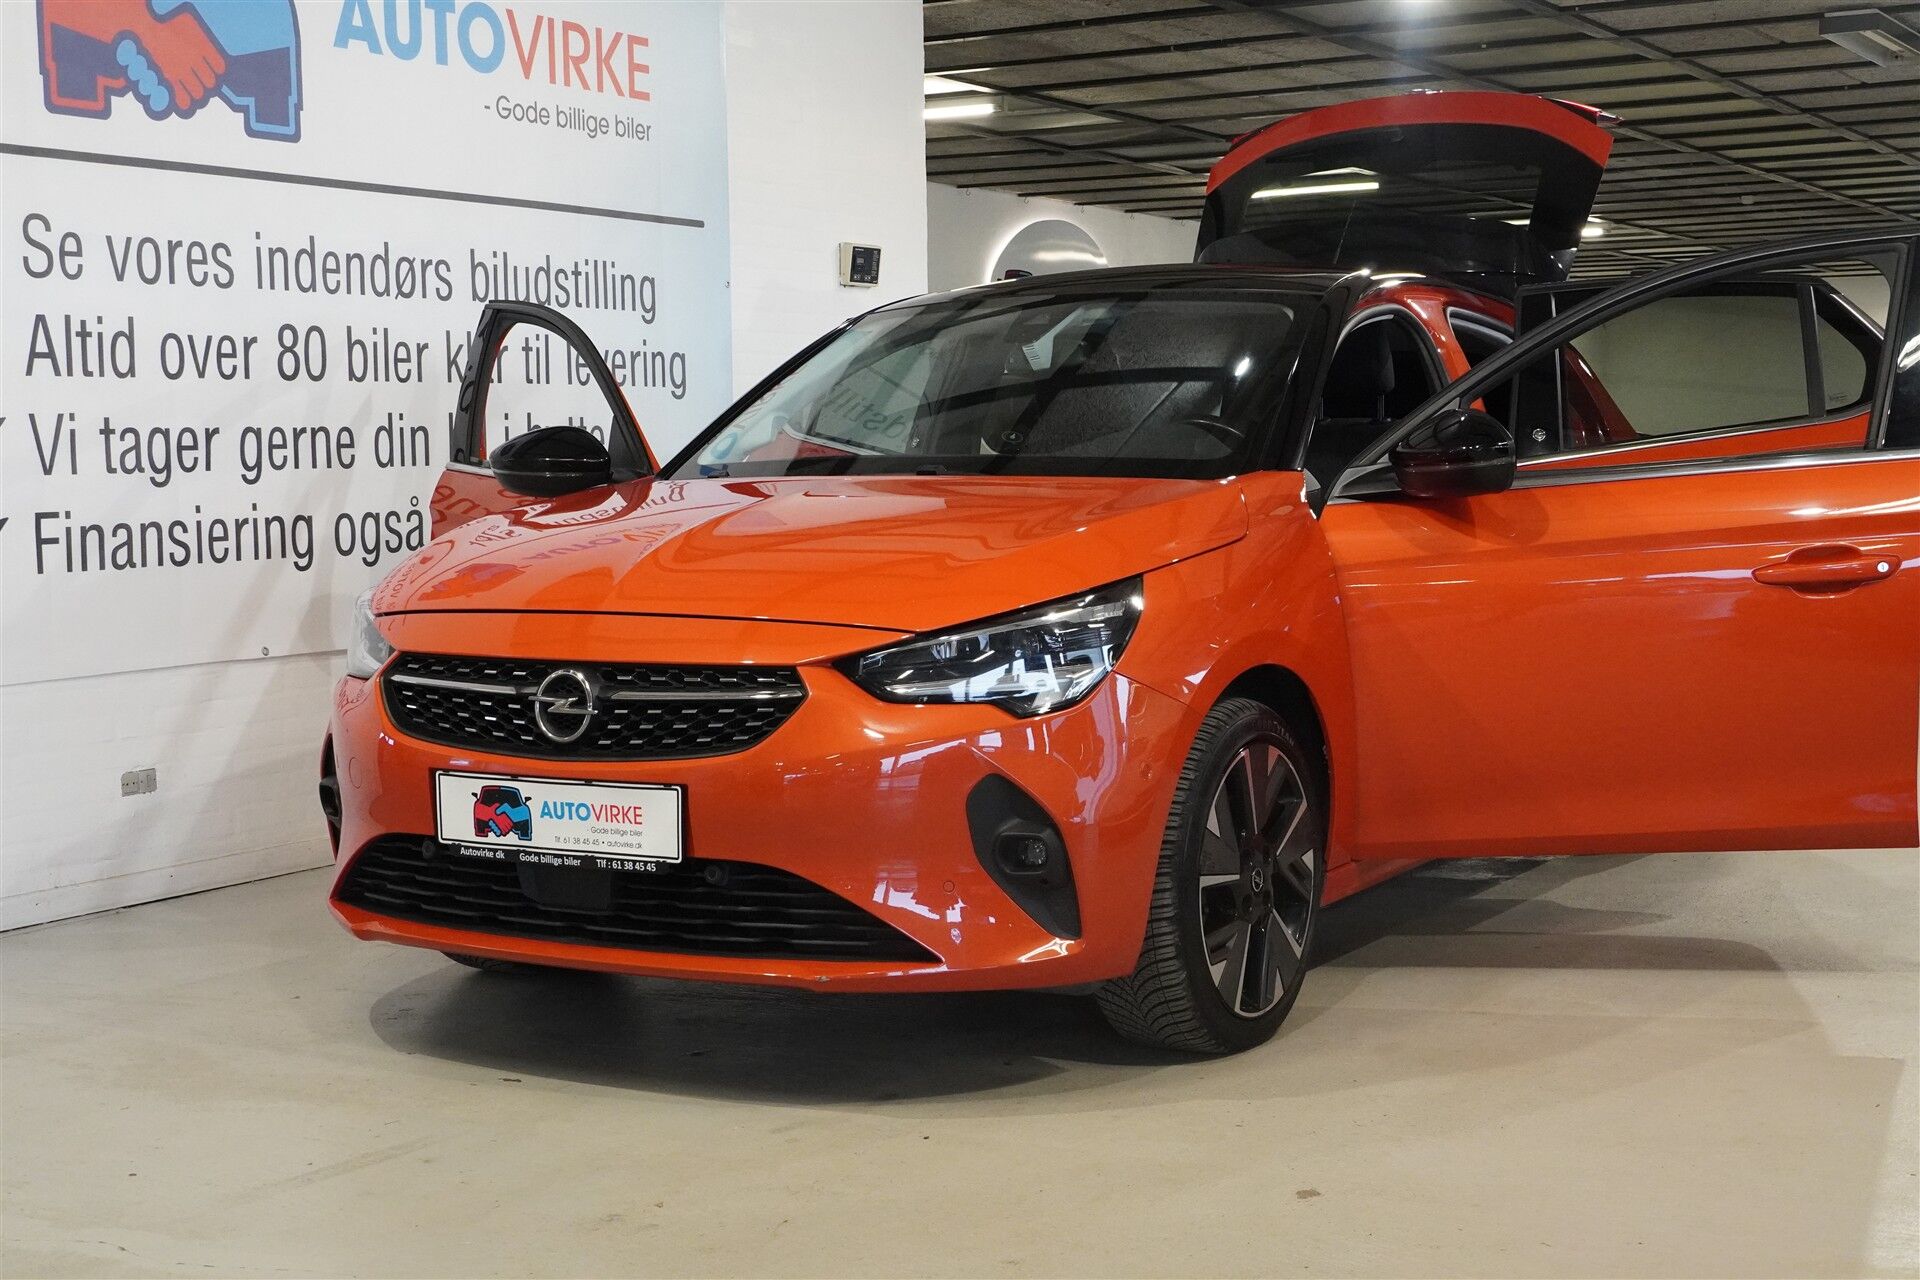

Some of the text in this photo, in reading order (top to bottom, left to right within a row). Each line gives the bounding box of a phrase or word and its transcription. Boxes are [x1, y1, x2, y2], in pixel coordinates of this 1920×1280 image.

[333, 0, 650, 102] AUTOVIRKE
[496, 95, 550, 126] Gode
[556, 104, 610, 138] billige
[615, 115, 651, 142] biler
[22, 212, 657, 324] Se vores indendørs biludstilling
[25, 313, 137, 379] Altid
[160, 332, 258, 380] over
[277, 323, 327, 382] 80
[346, 325, 429, 383] biler
[521, 332, 550, 385] til
[566, 338, 687, 400] leering
[28, 412, 78, 475] Vi
[99, 416, 219, 488] tager
[239, 426, 356, 485] gerne
[374, 411, 430, 468] din
[34, 502, 314, 575] Finansiering
[333, 495, 425, 568] også
[540, 800, 643, 825] AUTOVIRKE
[590, 826, 609, 835] Gode
[519, 852, 582, 867] Gode billige biler
[573, 837, 581, 845] 38
[582, 838, 590, 846] 45
[591, 838, 600, 846] 45
[612, 860, 622, 870] 61
[624, 861, 634, 870] 38
[635, 862, 645, 871] 45
[646, 862, 656, 872] 45
